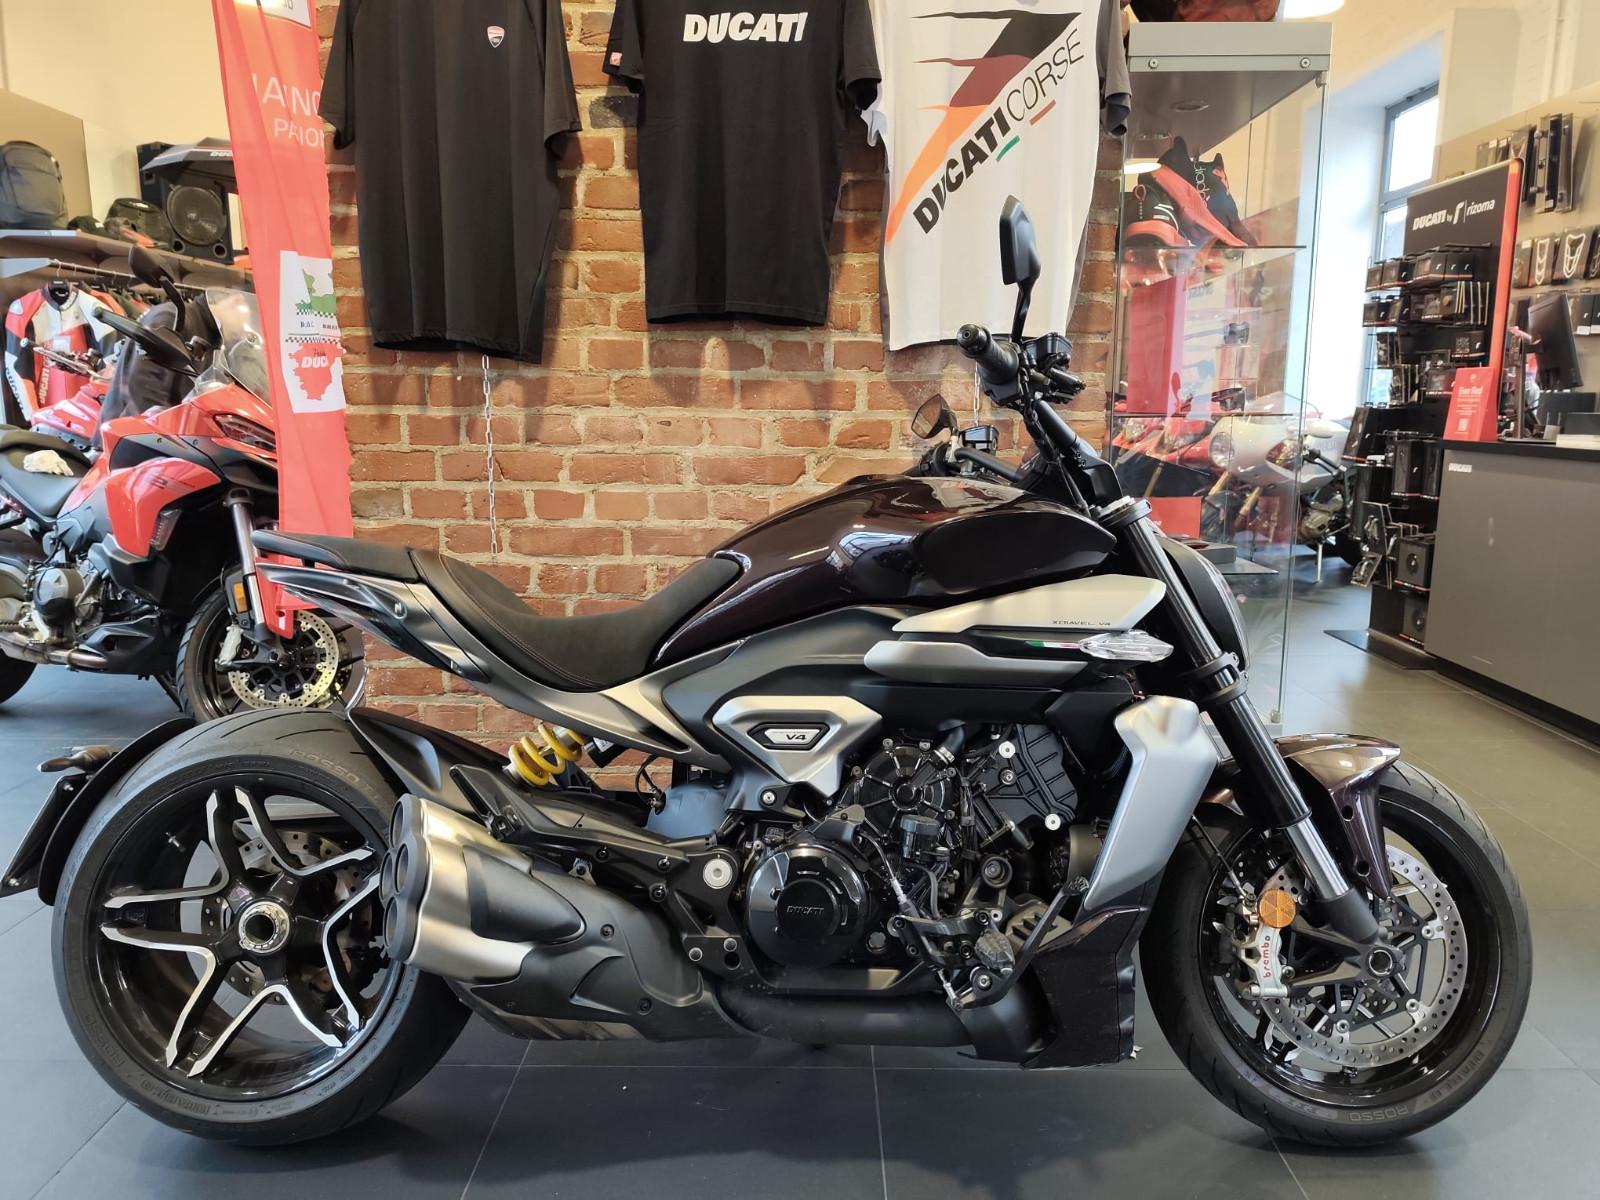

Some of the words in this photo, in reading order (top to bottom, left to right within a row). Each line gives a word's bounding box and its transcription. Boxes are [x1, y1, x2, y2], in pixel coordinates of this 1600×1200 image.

[683, 11, 808, 44] DUCATI
[912, 107, 1011, 234] DUCATI
[1006, 28, 1085, 122] CORSE
[1413, 210, 1447, 230] DUCATI
[1466, 200, 1496, 216] rizoma
[786, 905, 825, 917] DUCATI
[1261, 935, 1272, 978] brembo
[1349, 1103, 1409, 1121] ROSSO
